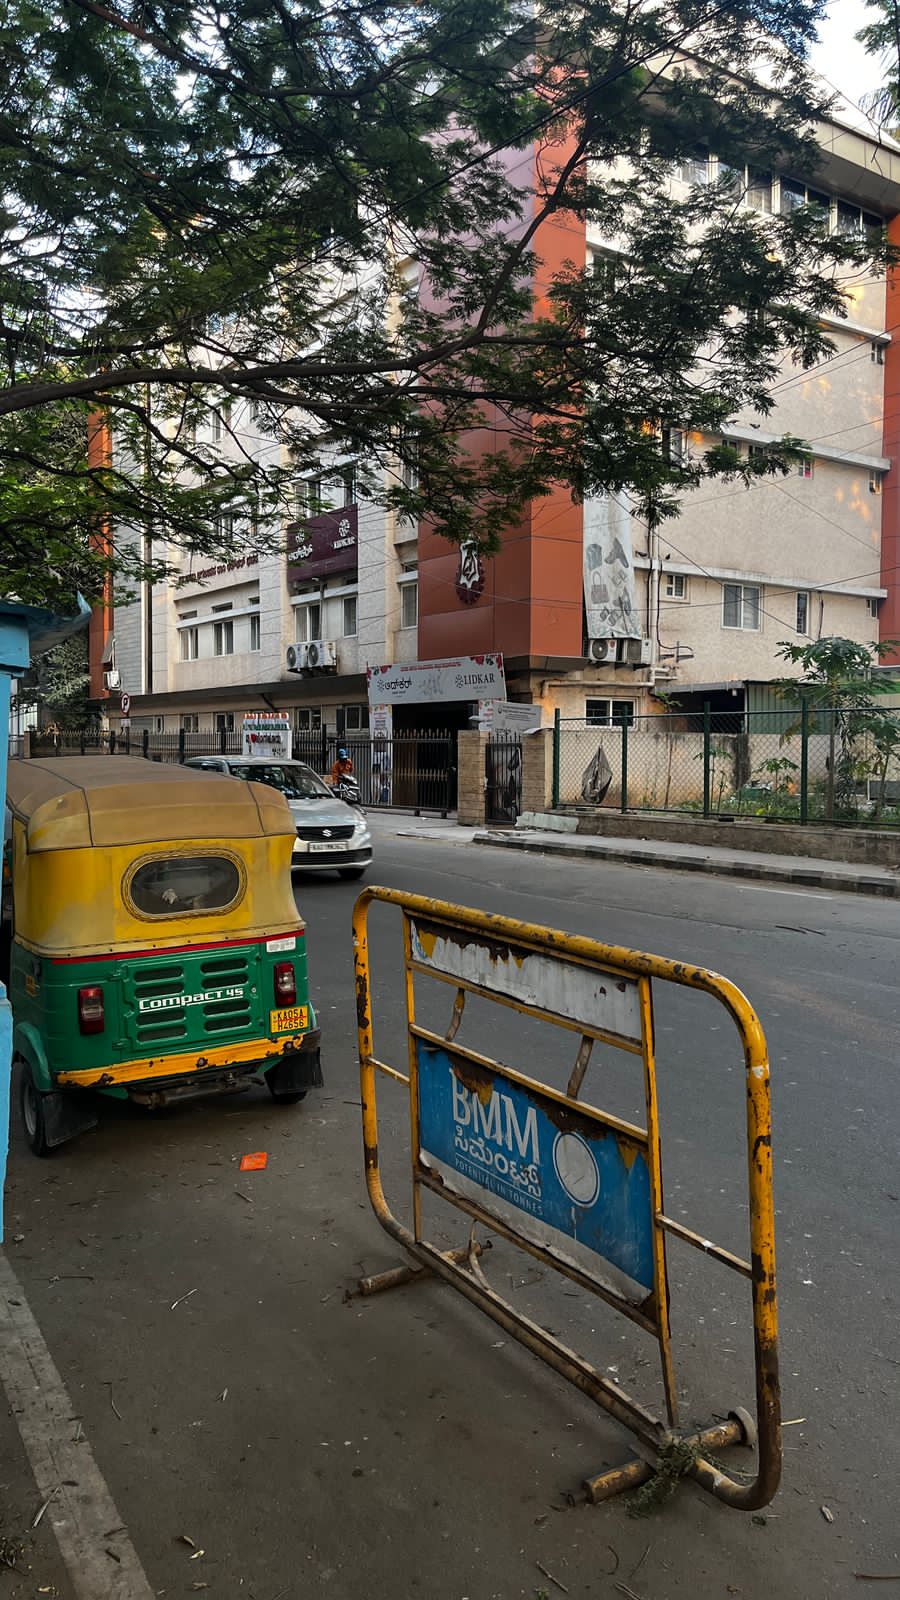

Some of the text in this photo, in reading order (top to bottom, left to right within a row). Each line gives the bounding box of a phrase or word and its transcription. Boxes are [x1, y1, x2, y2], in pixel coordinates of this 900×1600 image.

[464, 673, 495, 685] LIDKAR
[139, 990, 223, 1010] Compact
[277, 1008, 303, 1021] KA05A
[449, 1067, 540, 1166] BMM
[509, 1190, 543, 1216] TONNES
